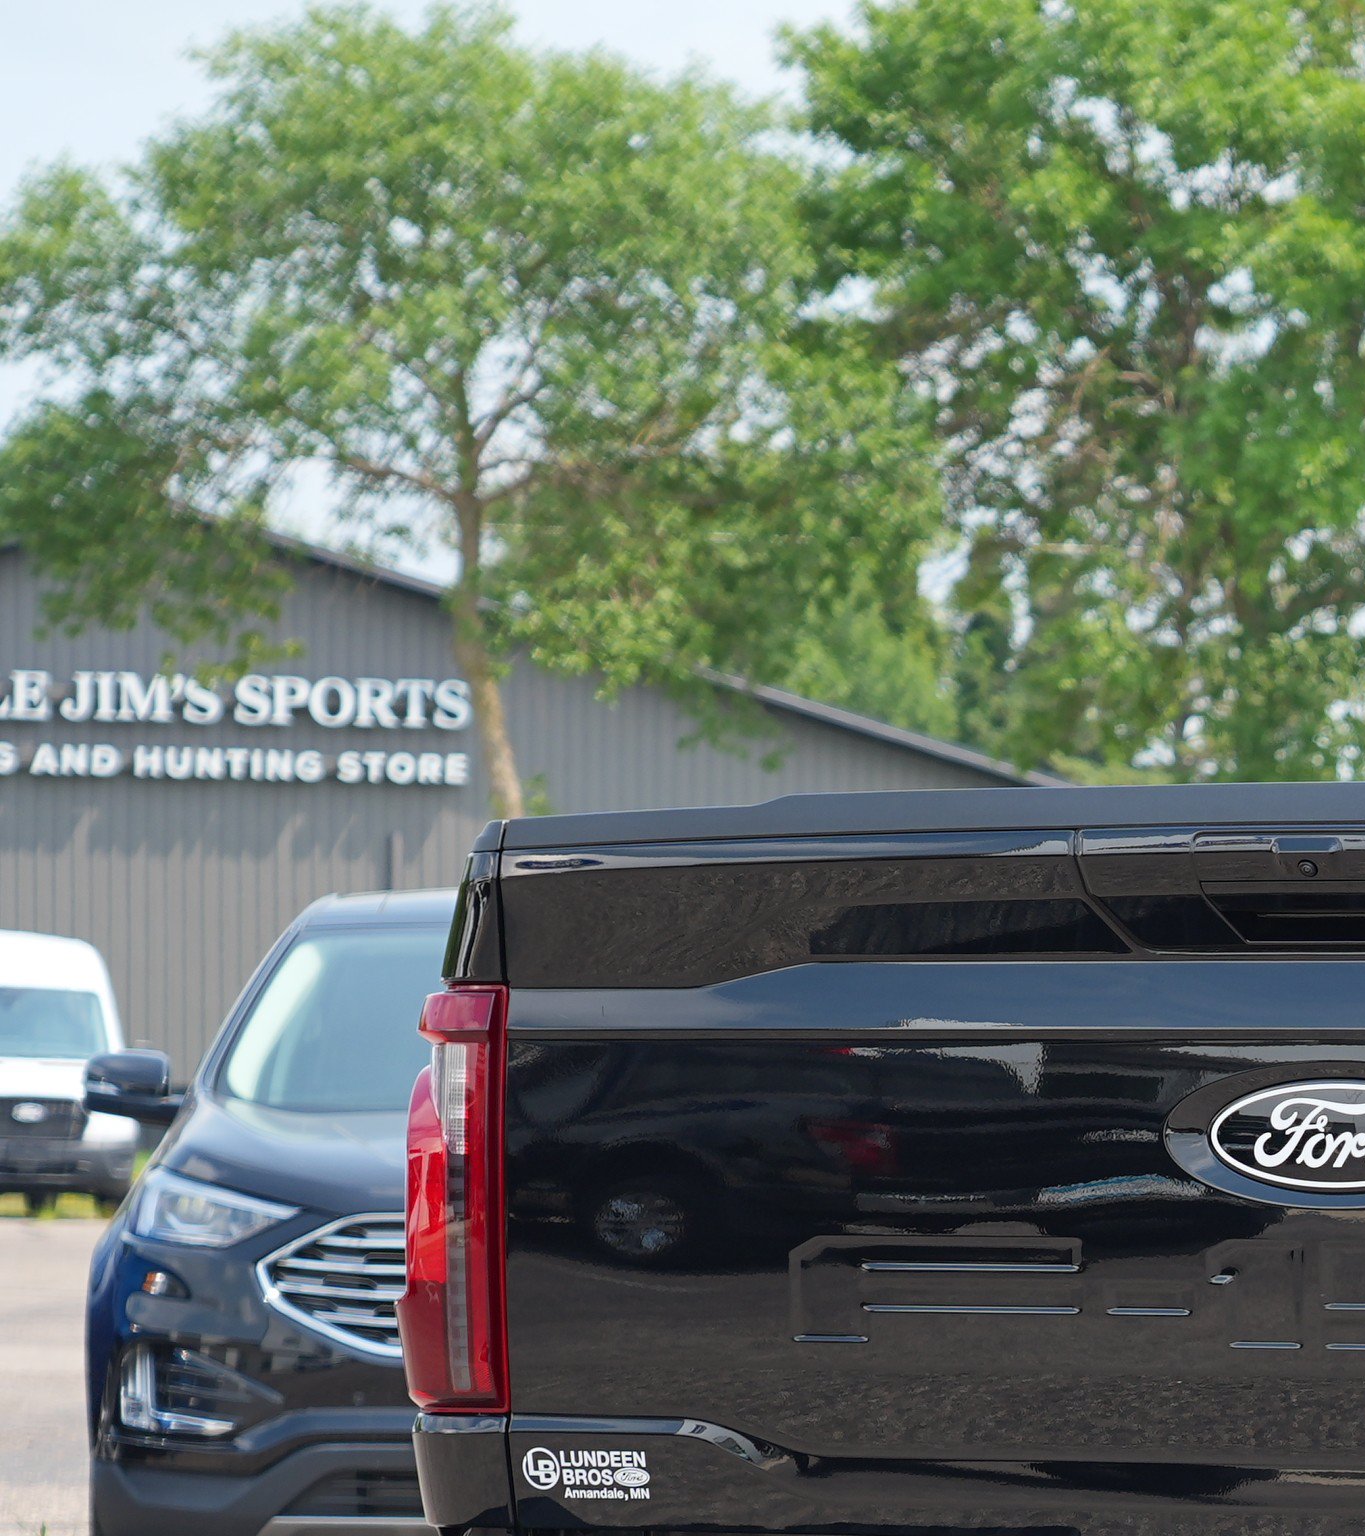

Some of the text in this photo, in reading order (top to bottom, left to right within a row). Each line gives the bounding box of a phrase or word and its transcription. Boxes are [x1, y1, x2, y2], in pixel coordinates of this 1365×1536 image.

[0, 669, 474, 731] E JIM'S SPORTS
[29, 742, 124, 778] AND
[133, 745, 327, 784] HUNTING
[336, 750, 471, 787] STORE
[559, 1450, 647, 1468] LUNDEEN
[562, 1468, 614, 1486] BROS
[564, 1487, 650, 1501] Annandale, MN
